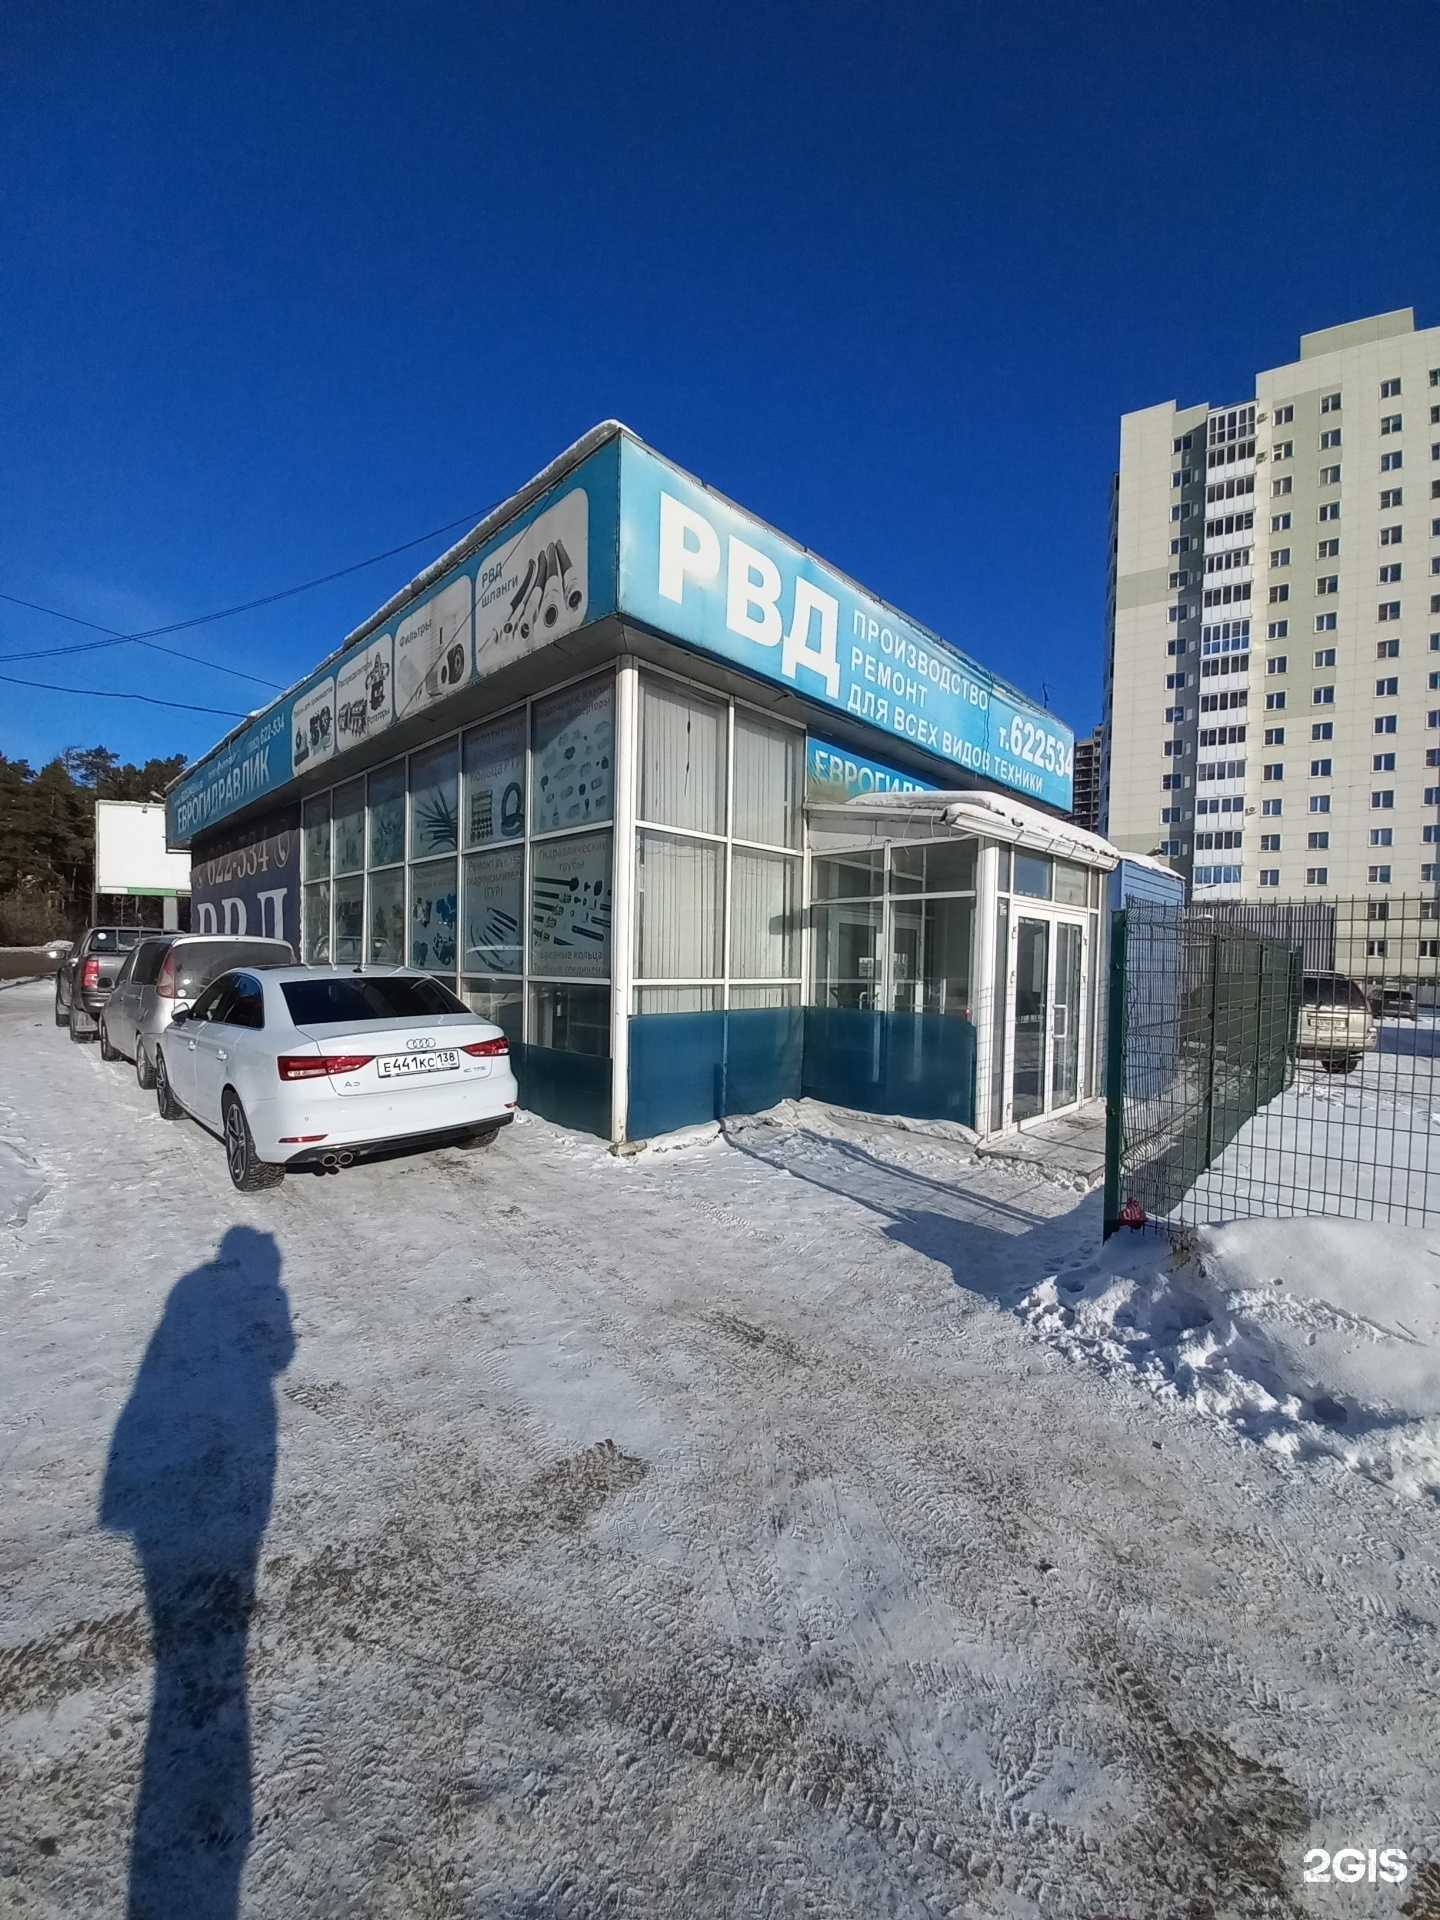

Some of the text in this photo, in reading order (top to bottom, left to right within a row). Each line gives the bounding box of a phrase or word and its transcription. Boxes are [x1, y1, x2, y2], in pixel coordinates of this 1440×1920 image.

[481, 562, 503, 588] РВД
[481, 576, 519, 608] шланги
[658, 490, 840, 698] РВД
[850, 645, 928, 708] РЕМОНТ
[853, 608, 988, 711] ПРОИЗВОДСТВО
[847, 683, 1043, 793] ДЛЯ ВСЕХ ВИДОВ ТЕХНИКИ
[177, 745, 270, 833] ЕВРОГИДРАВЛИК
[383, 1052, 455, 1074] Е441КС 138
